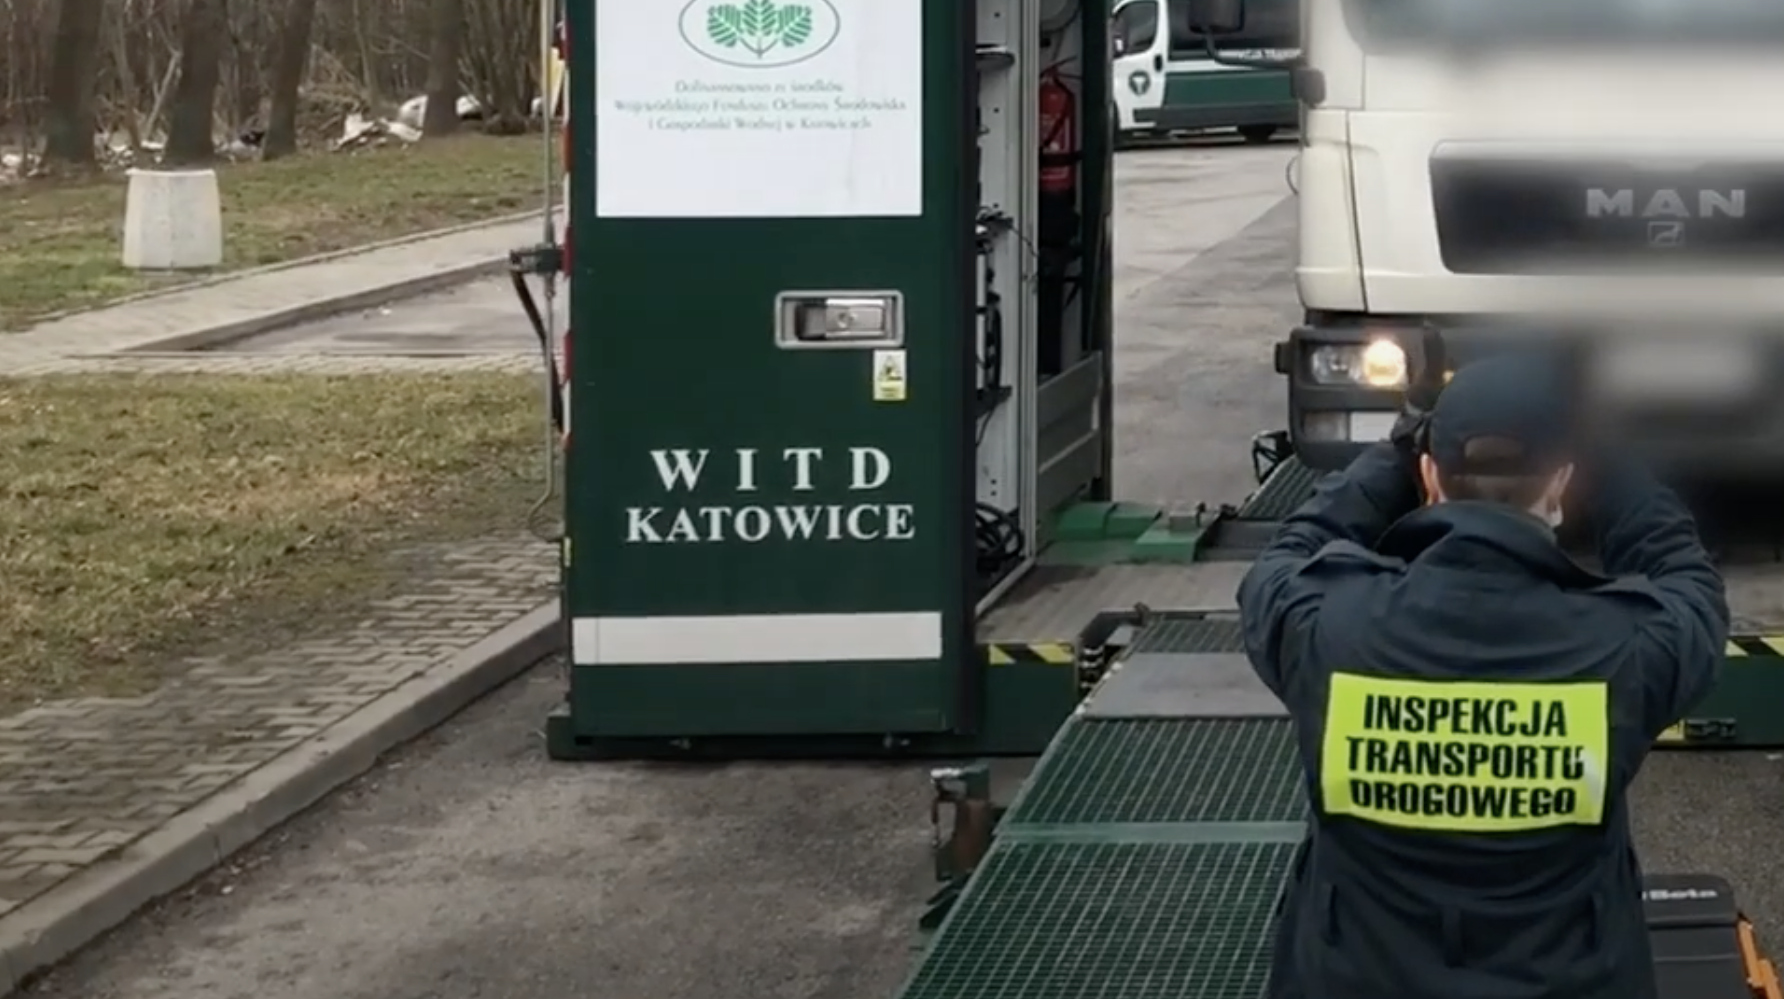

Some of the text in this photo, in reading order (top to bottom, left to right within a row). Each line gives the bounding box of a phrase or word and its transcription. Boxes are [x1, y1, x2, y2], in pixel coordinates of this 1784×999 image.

[1586, 188, 1745, 217] MAN
[626, 505, 915, 542] KATOWICE
[1363, 694, 1567, 737] INSPEKCJA
[1346, 736, 1584, 780] TRANSPORTU
[1349, 778, 1577, 819] DROGOWEGO
